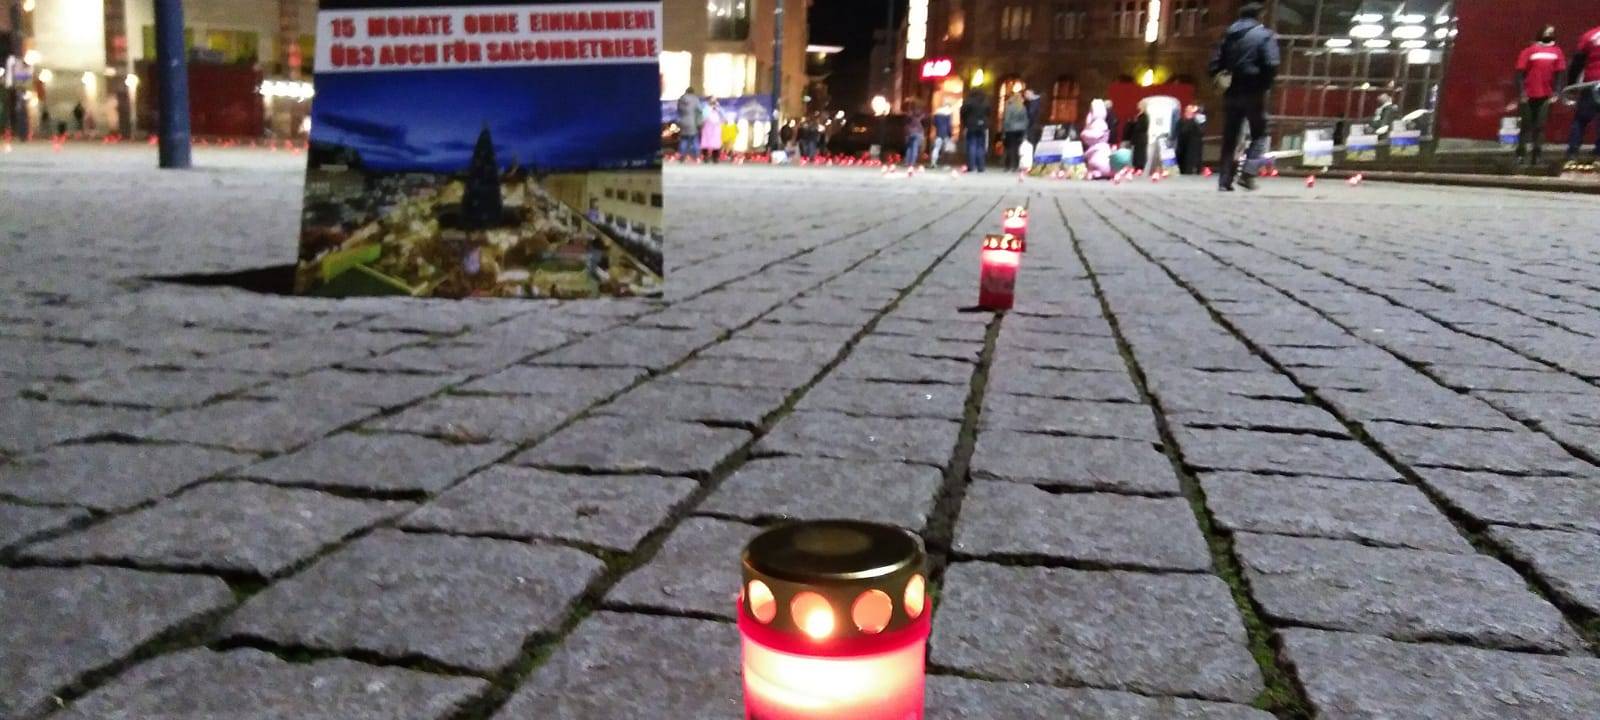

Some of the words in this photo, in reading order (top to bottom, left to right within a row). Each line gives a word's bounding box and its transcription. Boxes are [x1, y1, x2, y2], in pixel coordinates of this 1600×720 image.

[331, 17, 356, 38] 15
[368, 16, 453, 37] MONATE
[464, 13, 519, 34] OHNE
[529, 10, 655, 32] EINNAHMEN!
[379, 44, 438, 65] AUCH
[443, 39, 482, 63] FÜR
[486, 38, 657, 62] SAISONBETRIEBE
